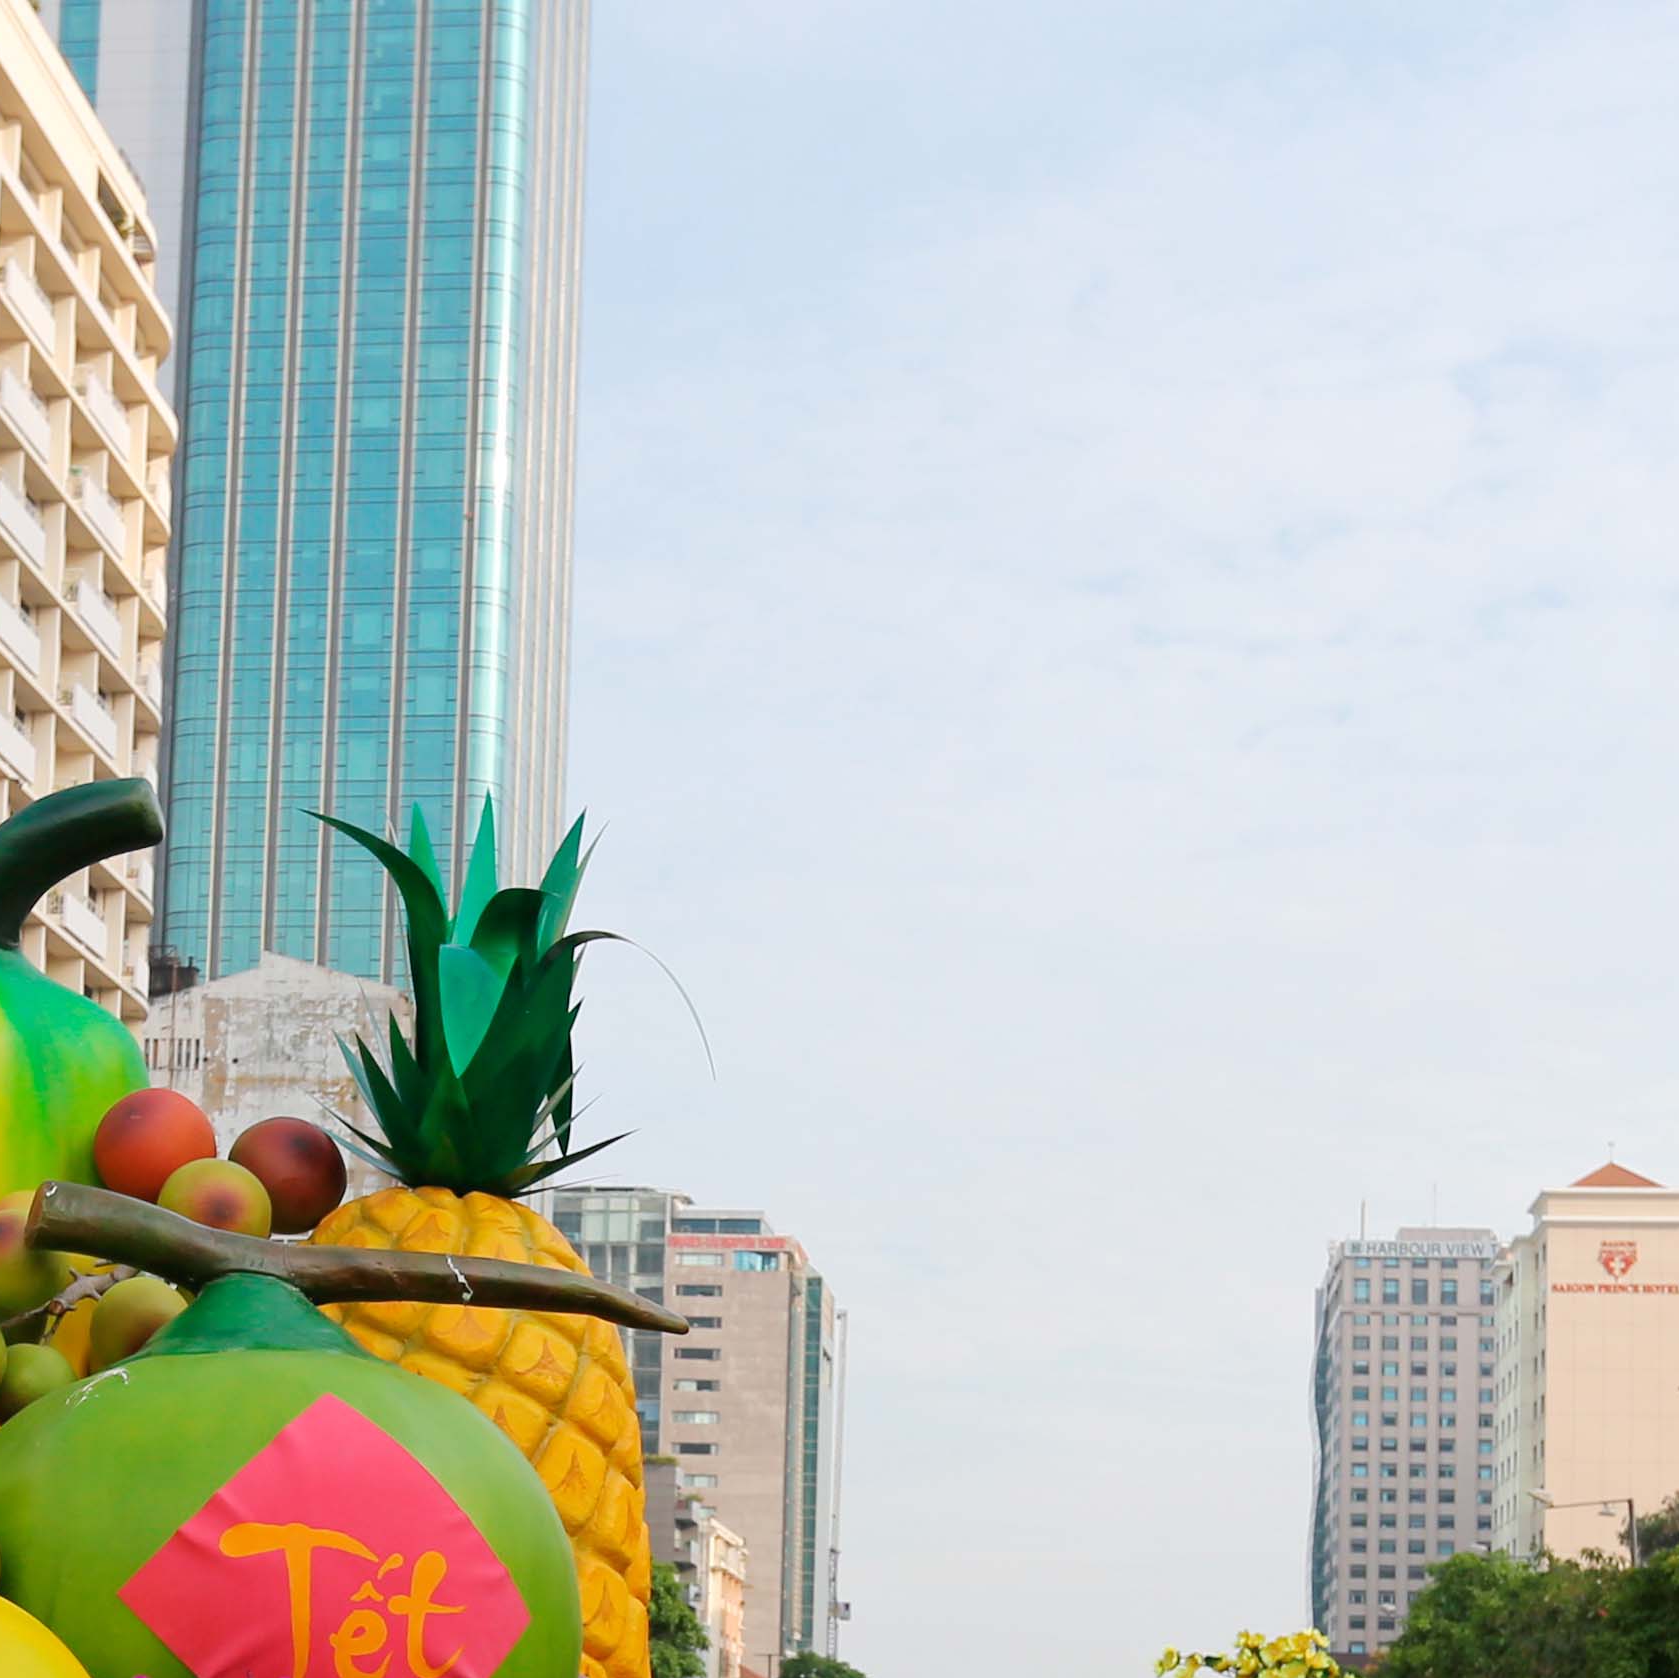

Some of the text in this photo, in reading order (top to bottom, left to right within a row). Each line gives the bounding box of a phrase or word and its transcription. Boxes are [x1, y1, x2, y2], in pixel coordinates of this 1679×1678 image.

[1366, 1242, 1485, 1257] HARBOUR VIEW
[1551, 1283, 1595, 1293] SAIGON
[1598, 1283, 1639, 1294] PRINCE
